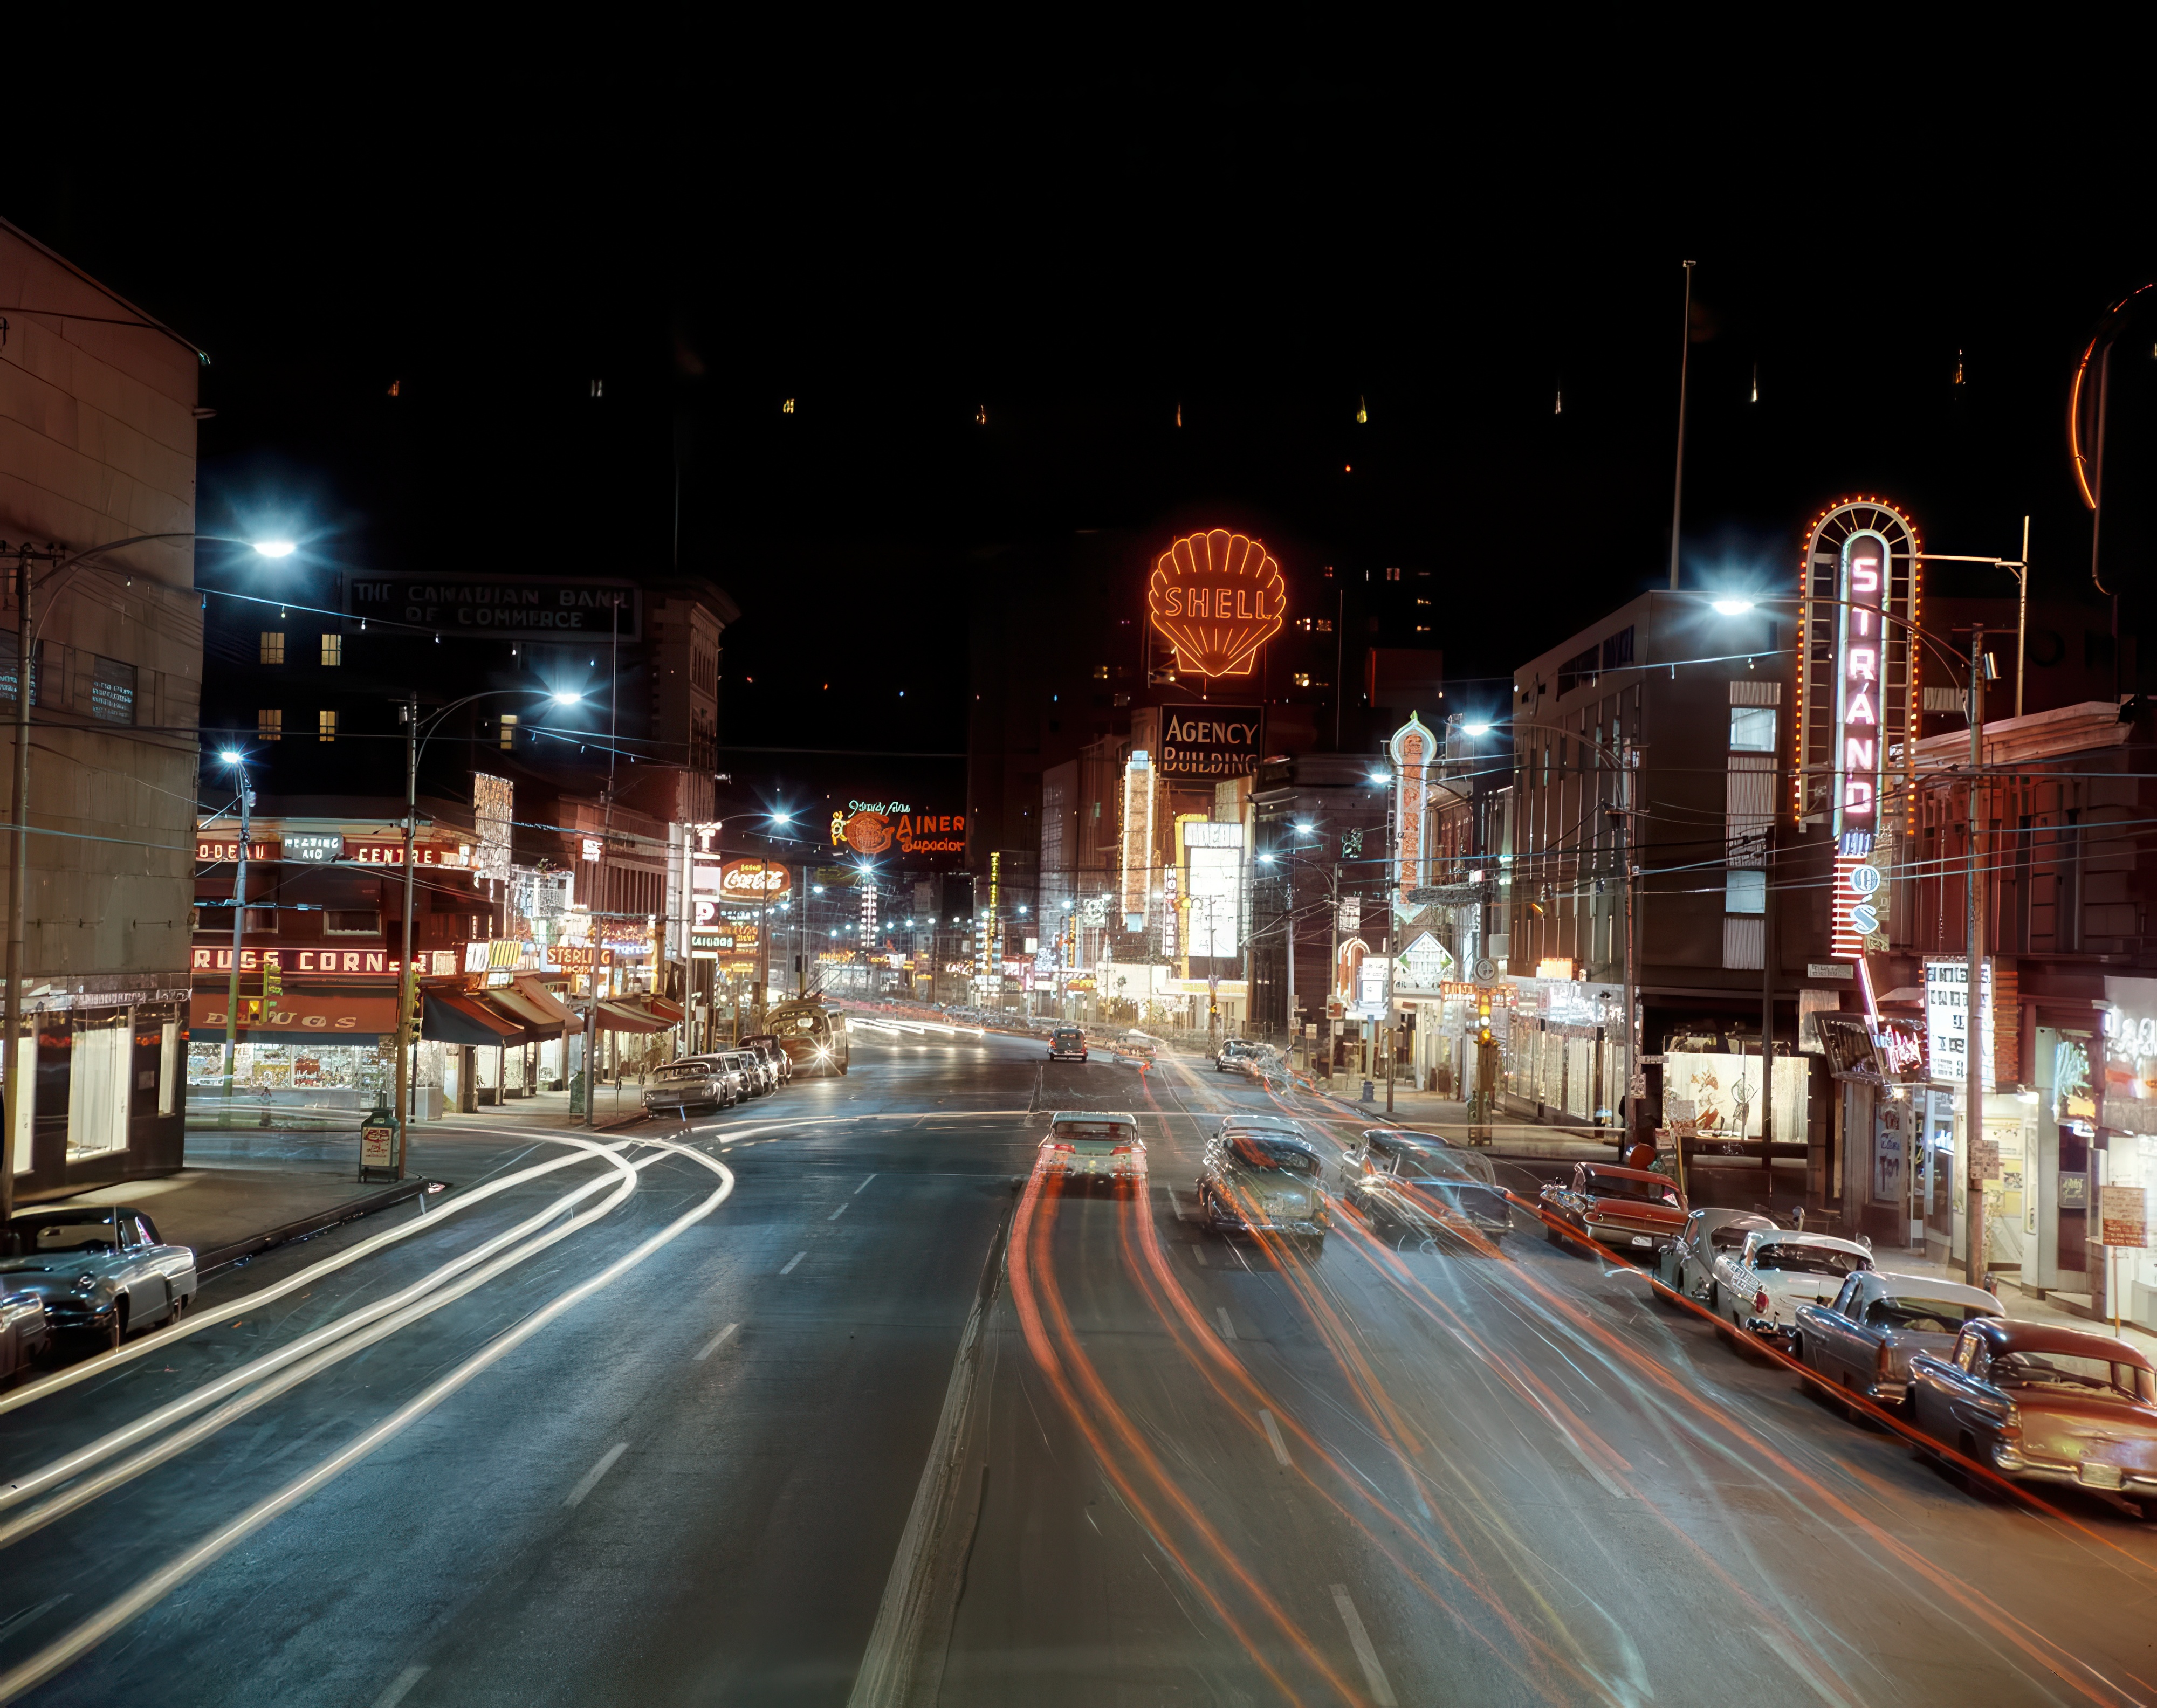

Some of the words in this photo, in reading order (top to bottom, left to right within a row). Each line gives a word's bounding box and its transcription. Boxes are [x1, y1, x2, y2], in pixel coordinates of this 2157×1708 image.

[408, 586, 540, 605] CANADIAN
[1165, 587, 1272, 619] SHELL
[457, 608, 583, 628] COMMERCE
[1844, 557, 1879, 815] STRAND
[1166, 714, 1258, 744] AGENCY
[1164, 747, 1258, 774] BUILDING
[359, 848, 433, 864] CENTRE
[547, 948, 610, 965] STERLIG
[203, 1011, 357, 1028] DUGS
